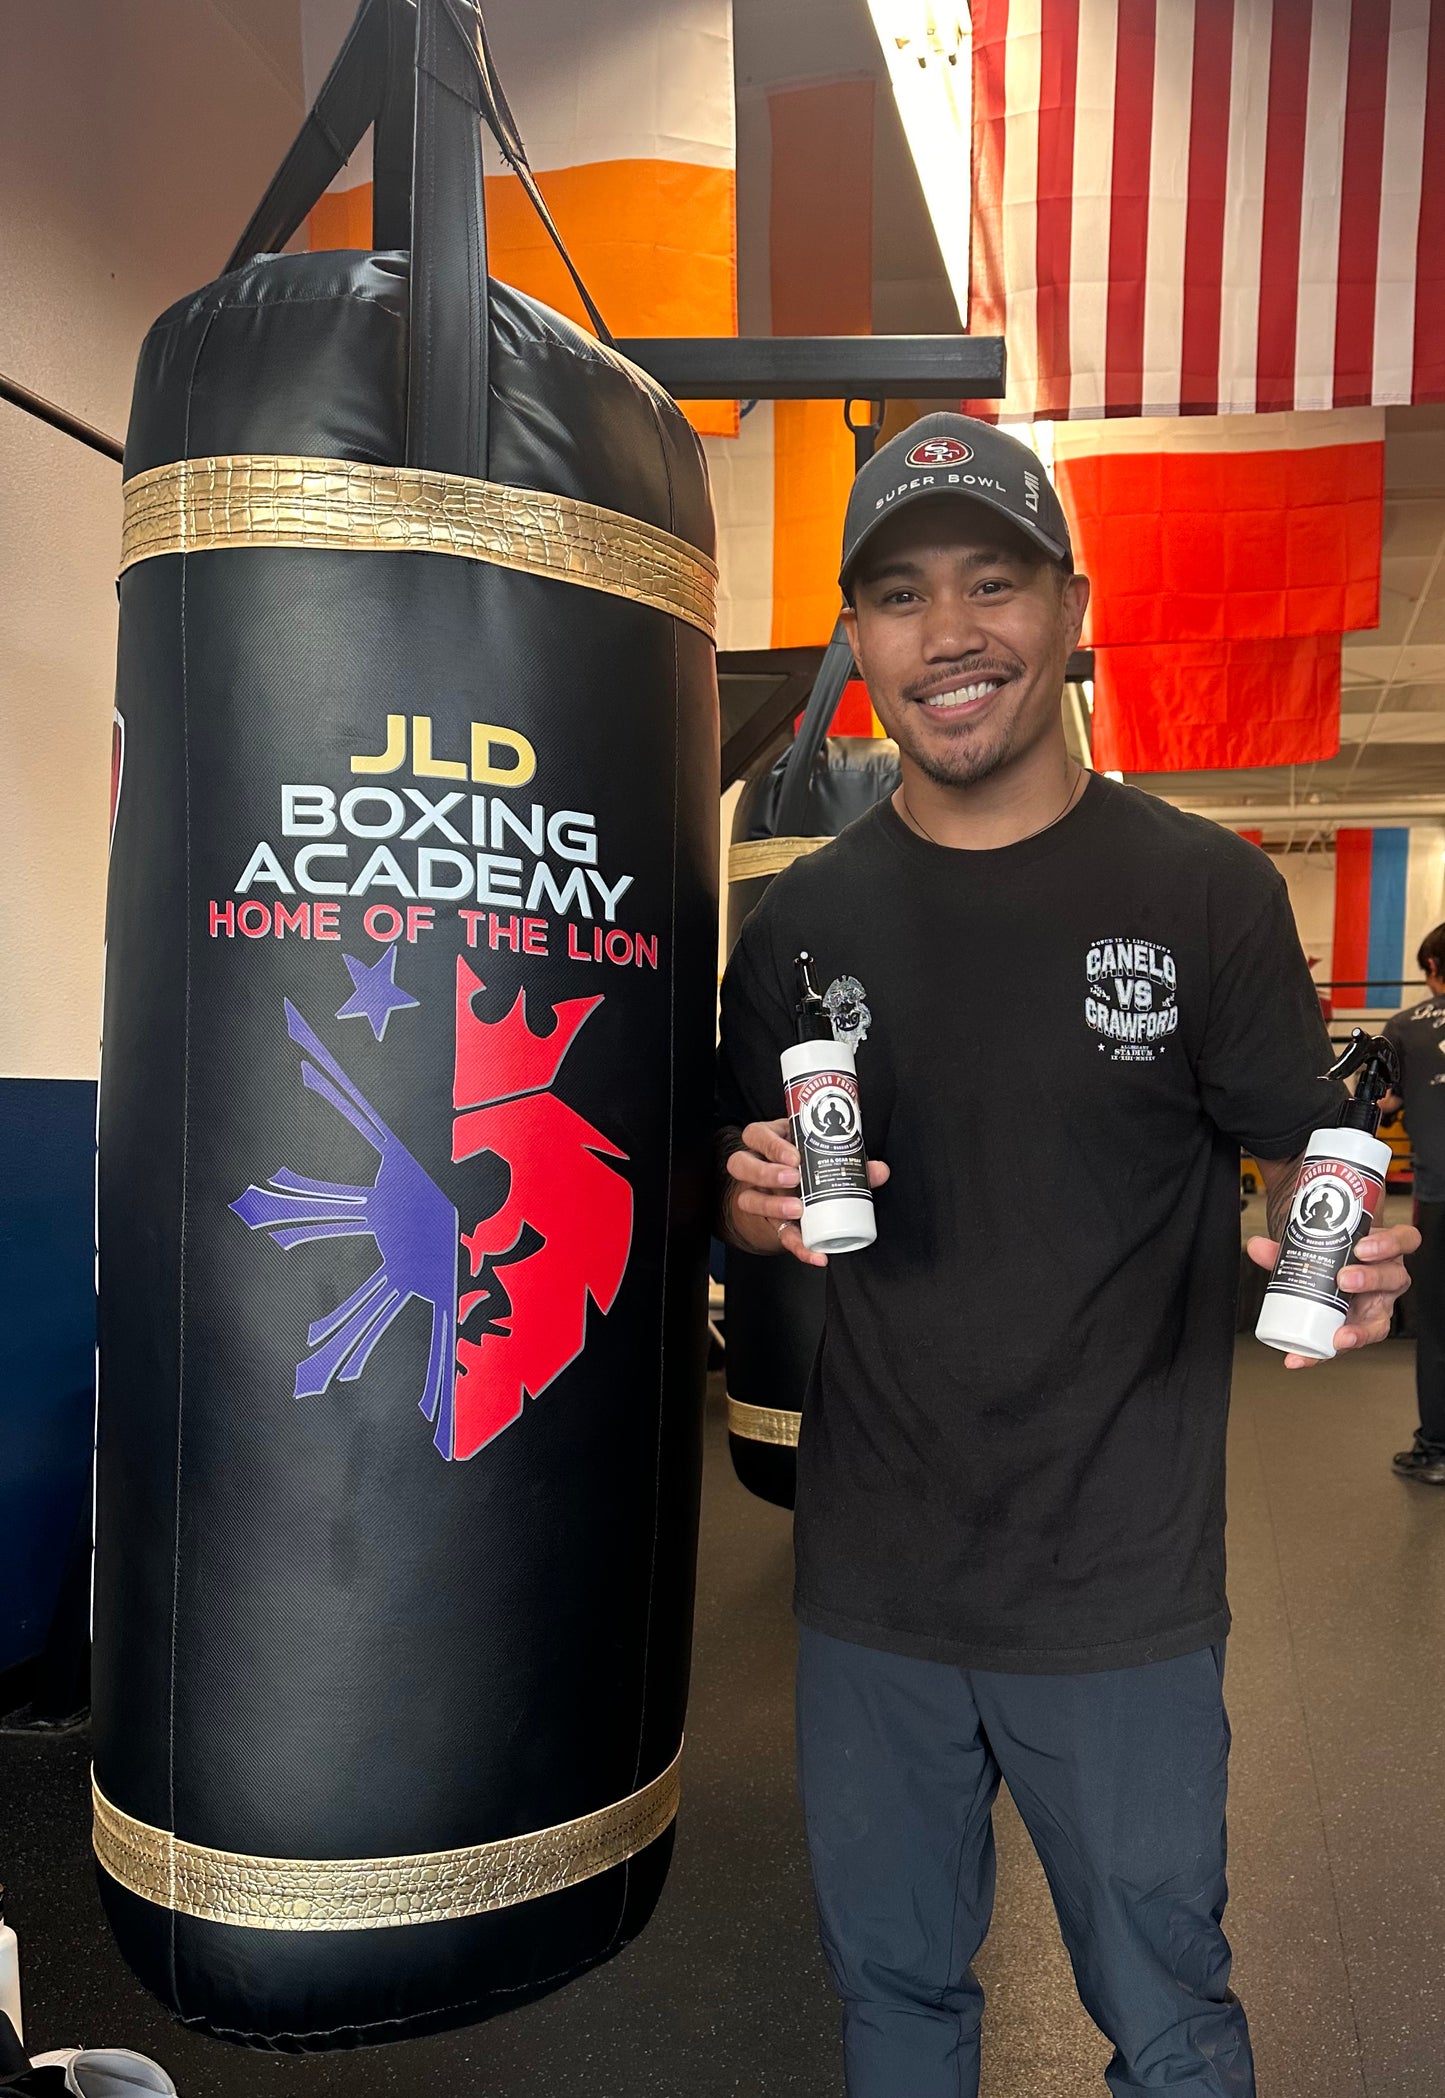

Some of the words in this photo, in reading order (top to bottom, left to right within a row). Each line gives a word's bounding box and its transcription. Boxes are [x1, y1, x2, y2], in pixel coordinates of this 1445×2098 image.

[924, 441, 960, 462] SF
[875, 474, 935, 510] SUPER
[948, 474, 1007, 493] BOWL
[350, 714, 537, 788] JLD
[281, 784, 598, 865] BOXING
[234, 841, 635, 922] ACADEMY
[209, 900, 341, 940] HOME
[363, 904, 435, 943] OF
[458, 909, 549, 956] THE
[568, 923, 658, 970] LION
[1086, 943, 1177, 991] CANELO
[1114, 978, 1153, 1012] VS
[1085, 996, 1178, 1043] CRAWFORD
[1114, 1048, 1153, 1056] STADIUM
[1304, 1163, 1338, 1182] BUSHIDO
[1340, 1167, 1364, 1194] FRESH
[1317, 1255, 1336, 1265] SPRAY
